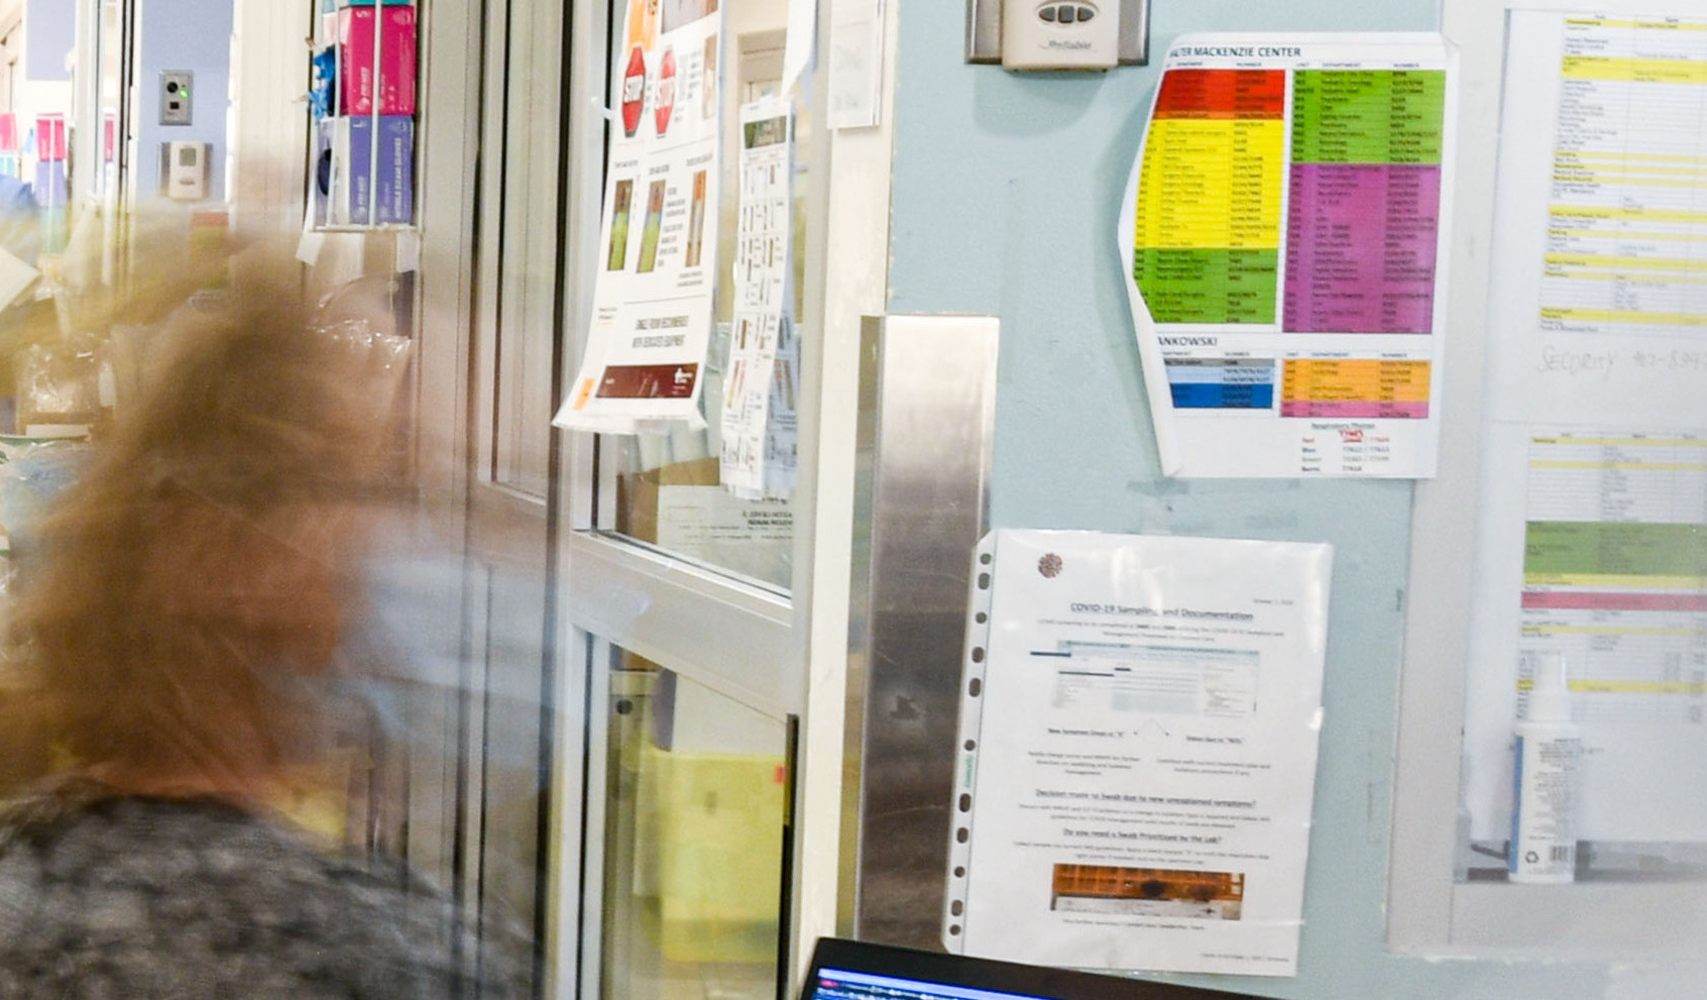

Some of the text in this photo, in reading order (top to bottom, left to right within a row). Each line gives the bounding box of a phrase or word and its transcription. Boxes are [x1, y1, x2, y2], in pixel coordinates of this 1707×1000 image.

[1194, 47, 1254, 58] MACKENZIE
[1258, 47, 1301, 58] CENTER
[623, 76, 644, 104] STOP
[655, 78, 675, 110] STOP
[1070, 602, 1115, 613] COVID-19
[1162, 608, 1179, 616] and
[1181, 608, 1254, 621] Documentation
